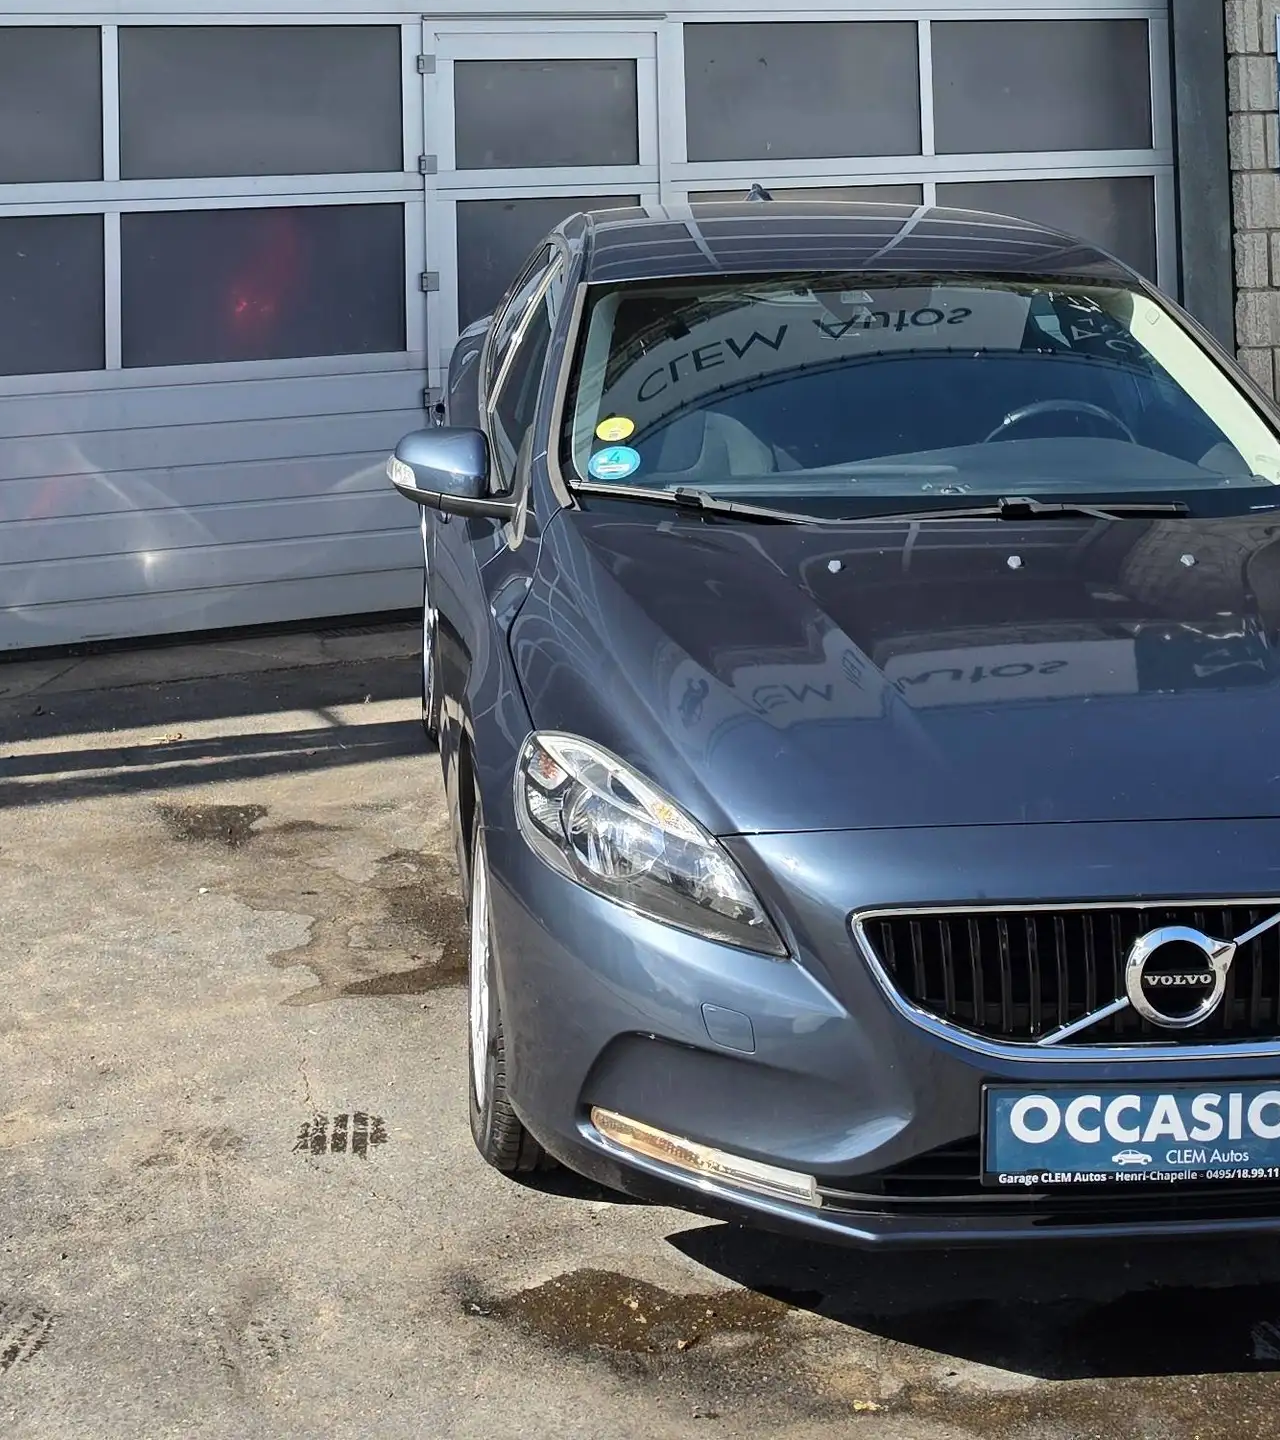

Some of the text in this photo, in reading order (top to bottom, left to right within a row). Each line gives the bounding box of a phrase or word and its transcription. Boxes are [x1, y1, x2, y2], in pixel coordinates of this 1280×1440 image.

[1144, 974, 1212, 986] VOLVO
[1166, 1148, 1249, 1165] CLEM Autos
[999, 1173, 1039, 1186] Garage
[1041, 1172, 1071, 1183] CLEM
[1073, 1172, 1107, 1182] Autos
[1115, 1170, 1198, 1183] Henri-Chapelle
[1206, 1168, 1279, 1179] 0495/18.99.11
